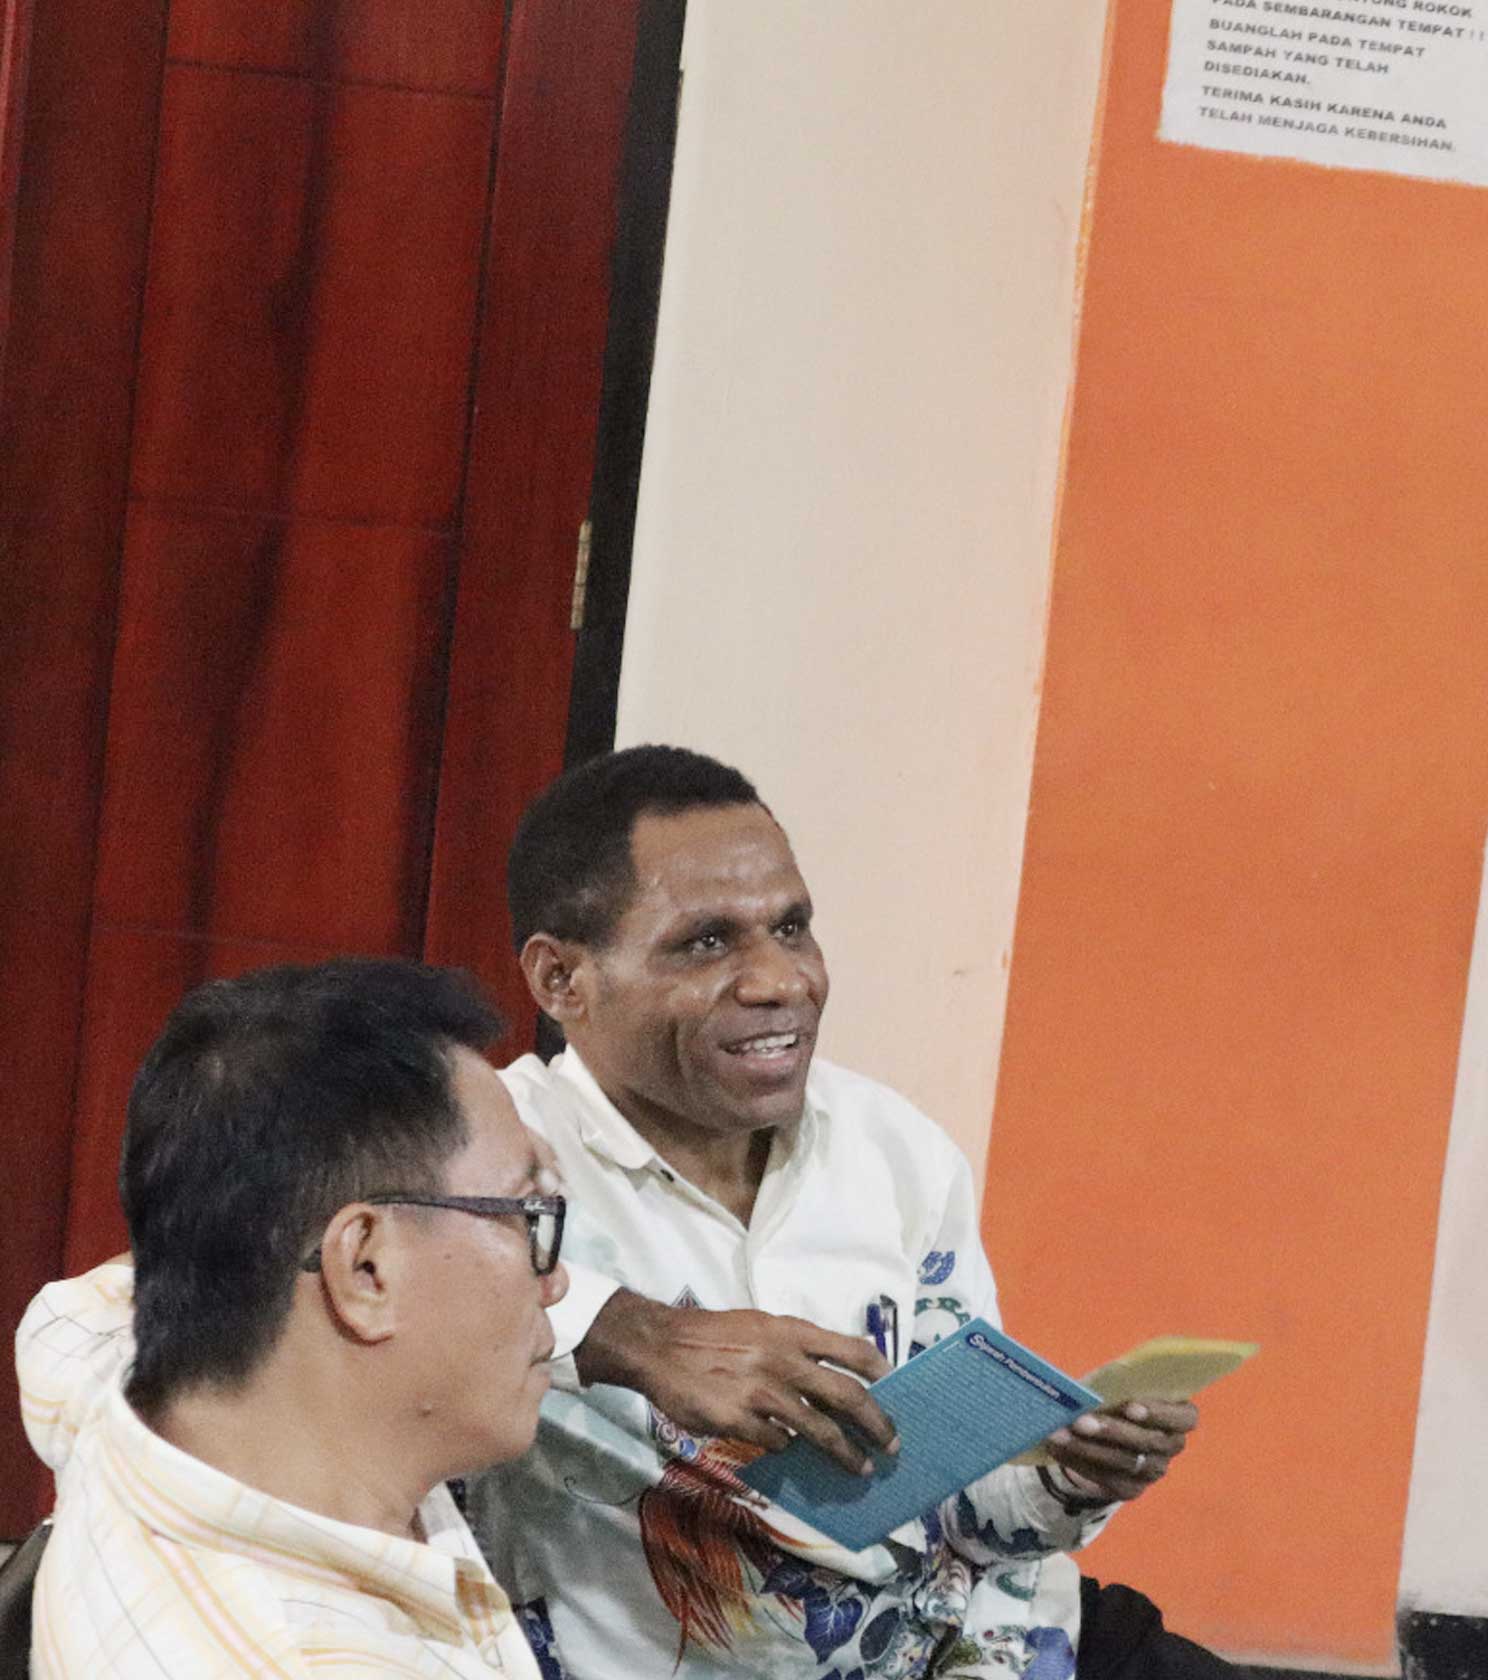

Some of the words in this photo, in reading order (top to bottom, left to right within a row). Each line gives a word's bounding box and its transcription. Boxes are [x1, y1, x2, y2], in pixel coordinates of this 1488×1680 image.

[1262, 1, 1391, 28] SEMBARANGAN
[1398, 19, 1465, 38] TEMPAT
[1413, 1, 1472, 18] ROKOK
[1209, 19, 1302, 41] BUANGLAH
[1308, 32, 1353, 47] PADA
[1359, 39, 1426, 57] TEMPAT
[1204, 60, 1311, 85] DISEDIAKAN.
[1207, 40, 1277, 59] SAMPAH
[1283, 50, 1329, 66] YANG
[1335, 57, 1389, 74] TELAH
[1199, 106, 1253, 123] TELAH
[1258, 115, 1339, 135] MENJAGA
[1202, 86, 1264, 104] TERIMA
[1270, 95, 1321, 112] KASIH
[1327, 103, 1395, 121] KARENA
[1401, 113, 1447, 129] ANDA
